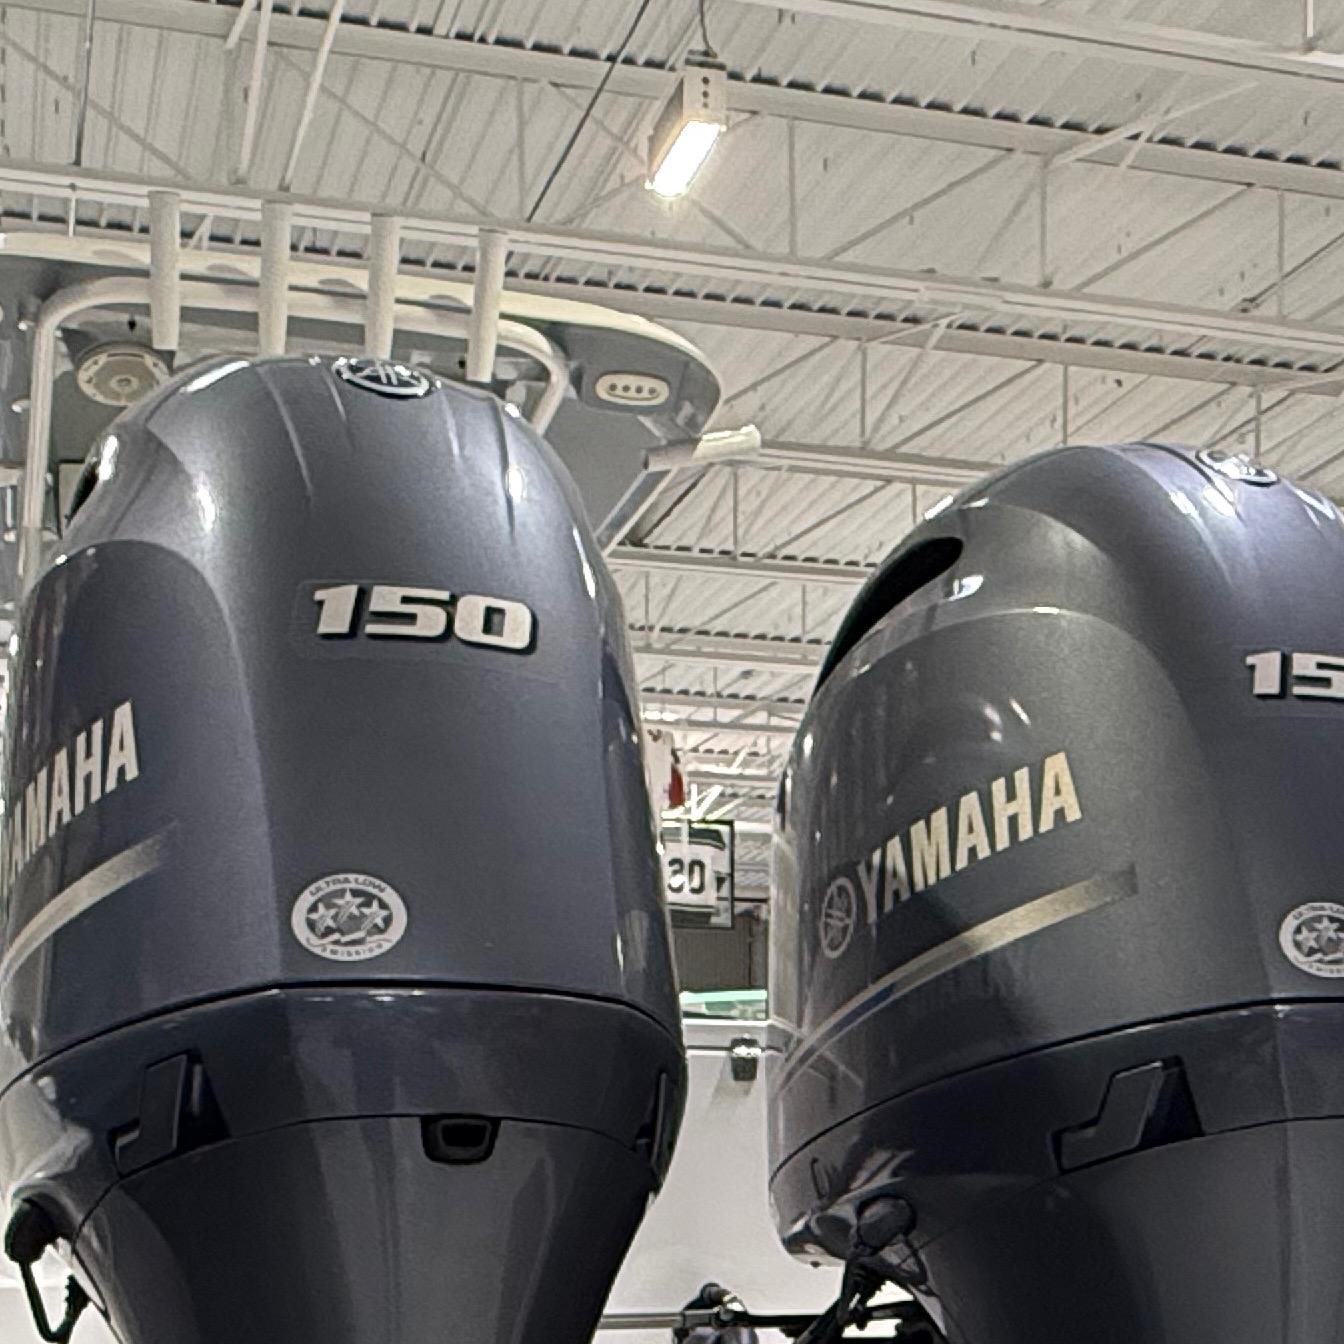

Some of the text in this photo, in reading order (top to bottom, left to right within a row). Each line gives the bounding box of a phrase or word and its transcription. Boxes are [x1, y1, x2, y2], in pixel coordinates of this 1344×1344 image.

[313, 583, 535, 652] 150
[7, 700, 139, 886] AMAHA
[856, 751, 1083, 926] YAMAHA
